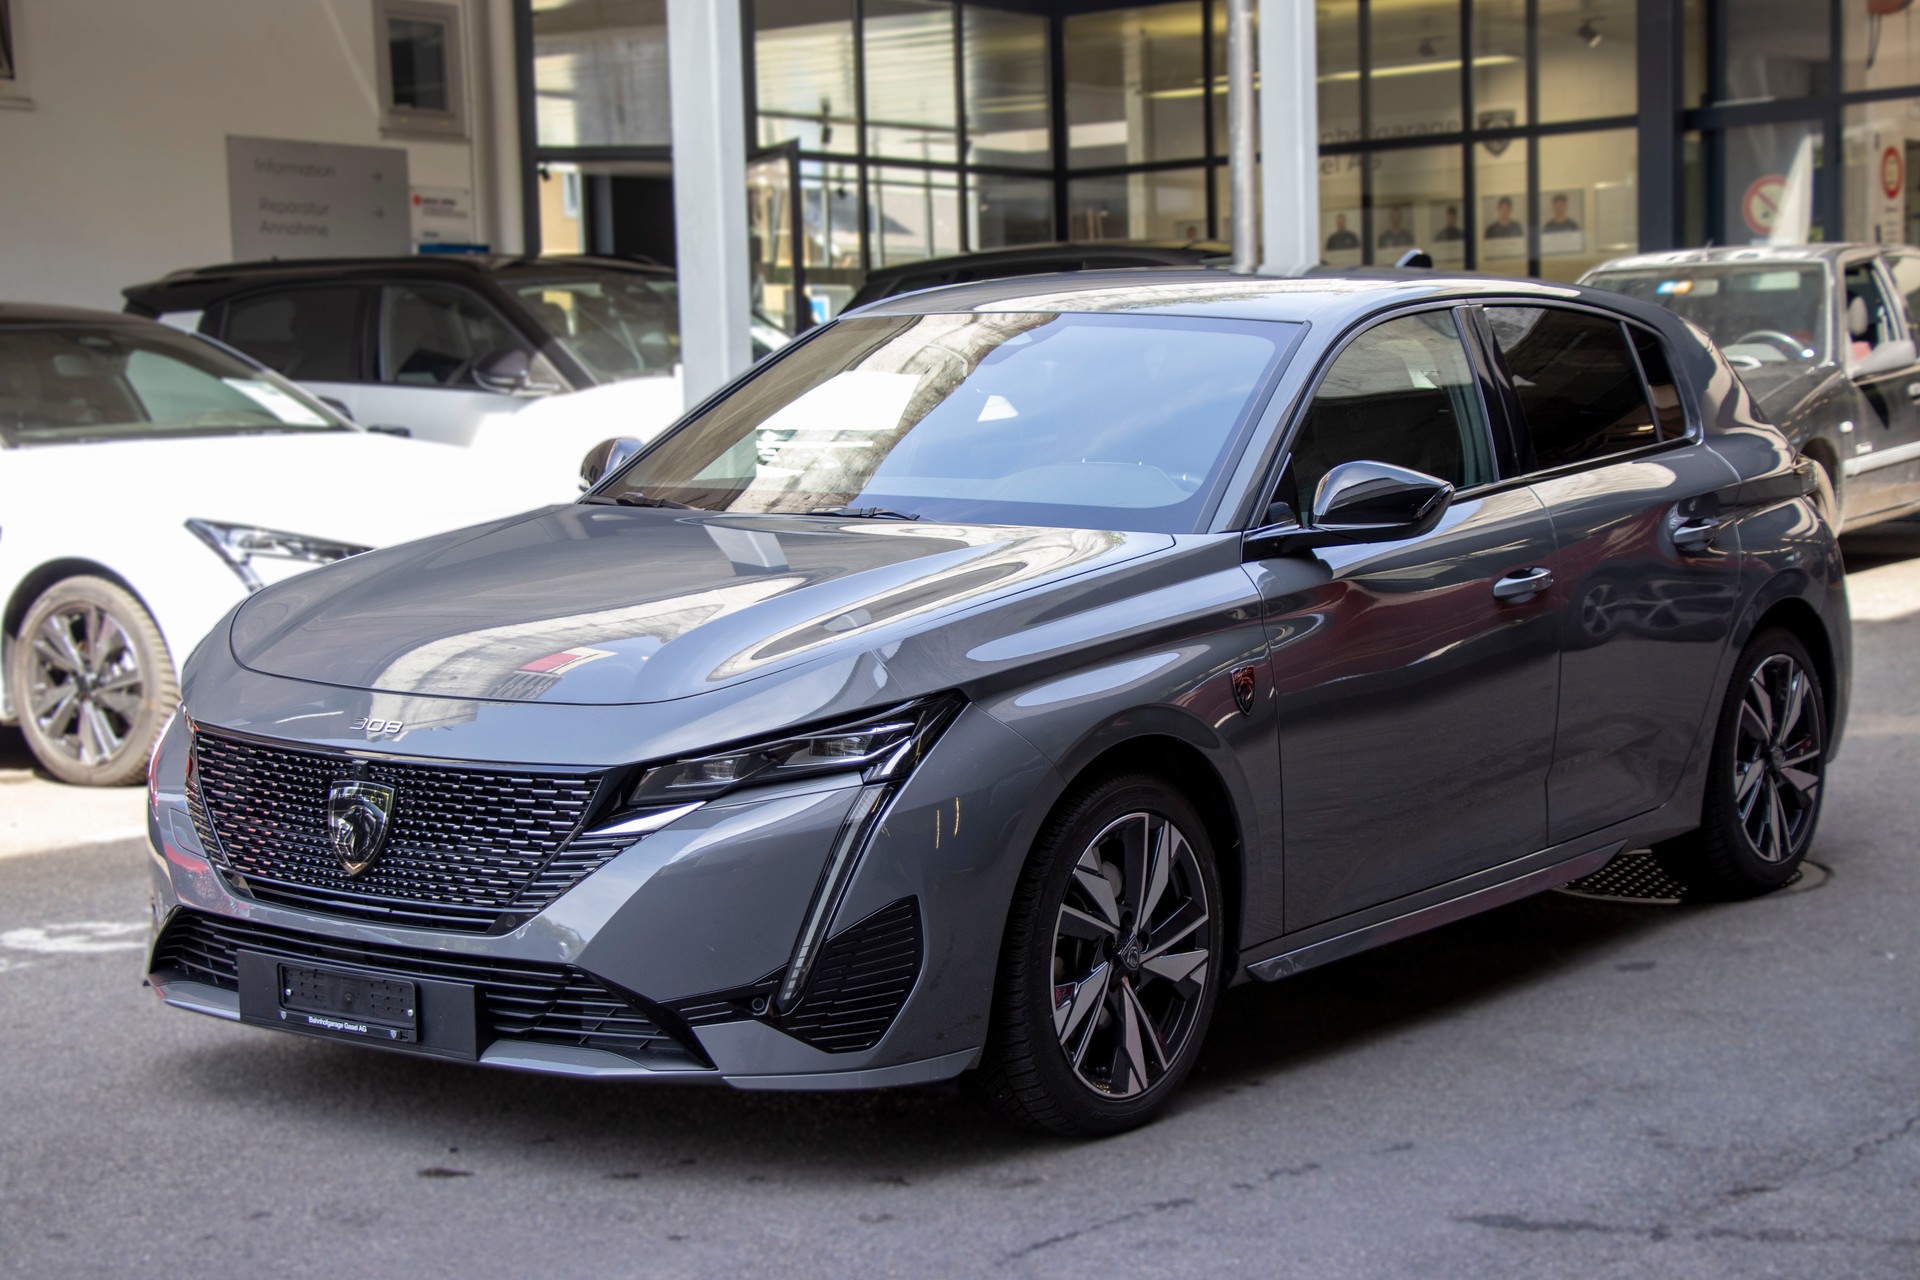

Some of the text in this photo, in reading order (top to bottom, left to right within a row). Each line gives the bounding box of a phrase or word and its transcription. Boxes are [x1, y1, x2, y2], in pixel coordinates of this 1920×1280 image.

[254, 158, 337, 178] Information
[259, 197, 330, 216] Reparatur
[260, 219, 330, 239] Annahme
[350, 717, 404, 734] 308
[358, 1024, 368, 1033] AG
